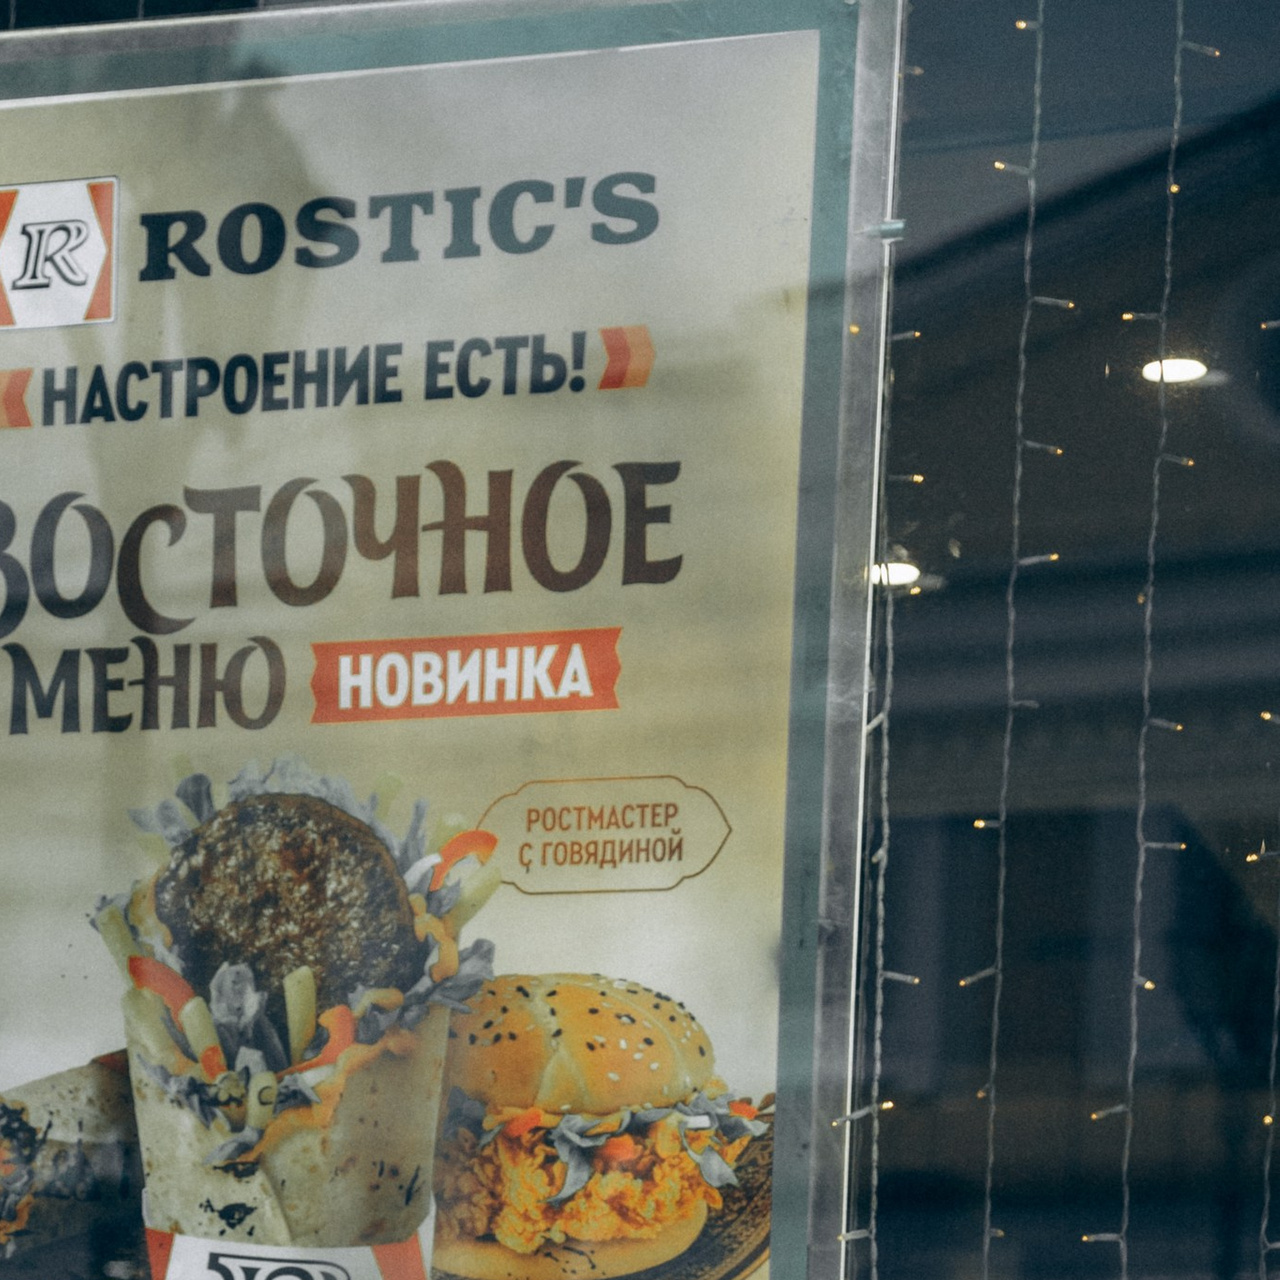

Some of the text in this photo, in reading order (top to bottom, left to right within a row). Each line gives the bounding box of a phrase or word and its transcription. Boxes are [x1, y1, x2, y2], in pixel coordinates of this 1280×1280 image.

[138, 171, 660, 282] ROSTIC'S
[41, 331, 587, 427] НАСТРОЕНИЕ ЕСТЬ!
[1, 635, 595, 736] МЕНЮ НОВИНКА
[525, 802, 680, 833] РОСТМАСТЕР
[541, 829, 683, 869] ГОВЯДИНОЙ
